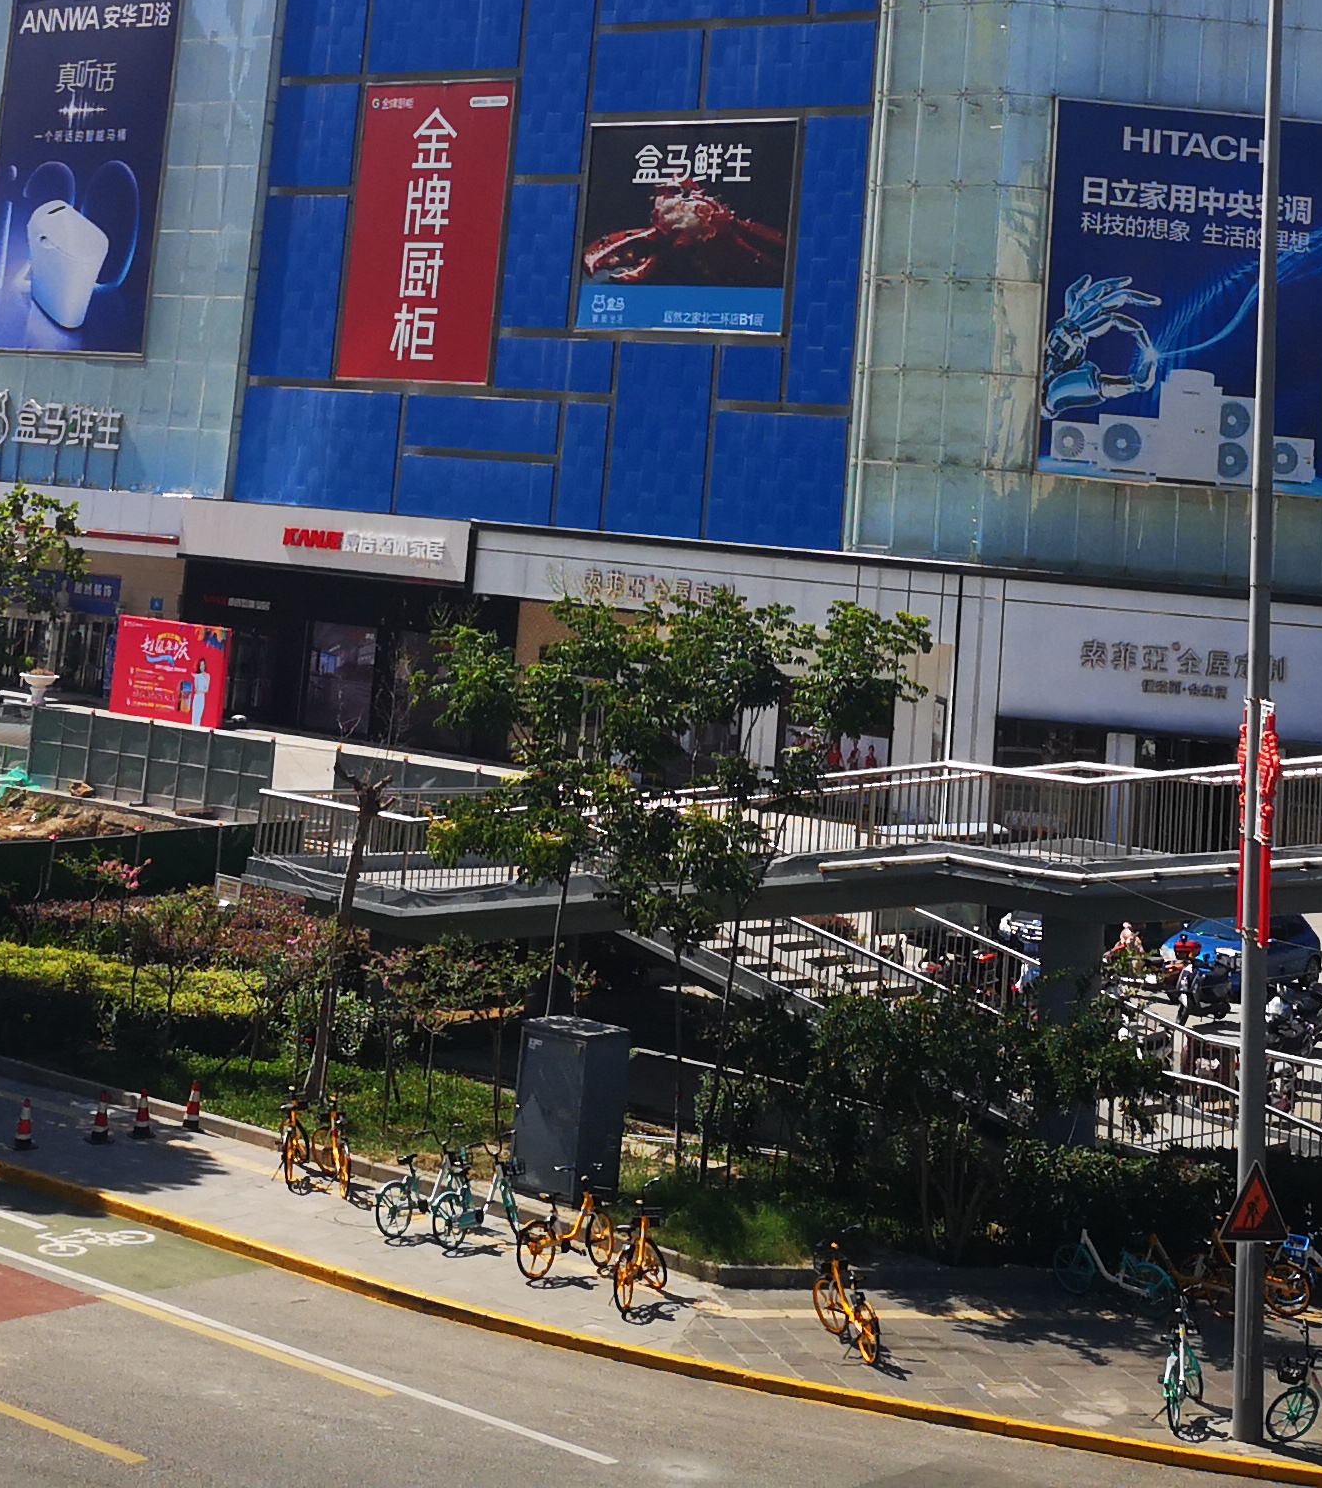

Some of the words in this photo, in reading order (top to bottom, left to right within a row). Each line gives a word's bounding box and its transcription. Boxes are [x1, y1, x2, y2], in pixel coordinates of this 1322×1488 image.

[19, 6, 100, 34] ANNWA
[103, 2, 172, 29] 安华卫浴
[632, 142, 753, 185] 盒马鲜生
[1123, 125, 1265, 163] HITACH
[389, 106, 458, 362] 金牌厨柜
[1081, 212, 1190, 243] 科技的想象
[12, 399, 124, 450] 盒马鲜生
